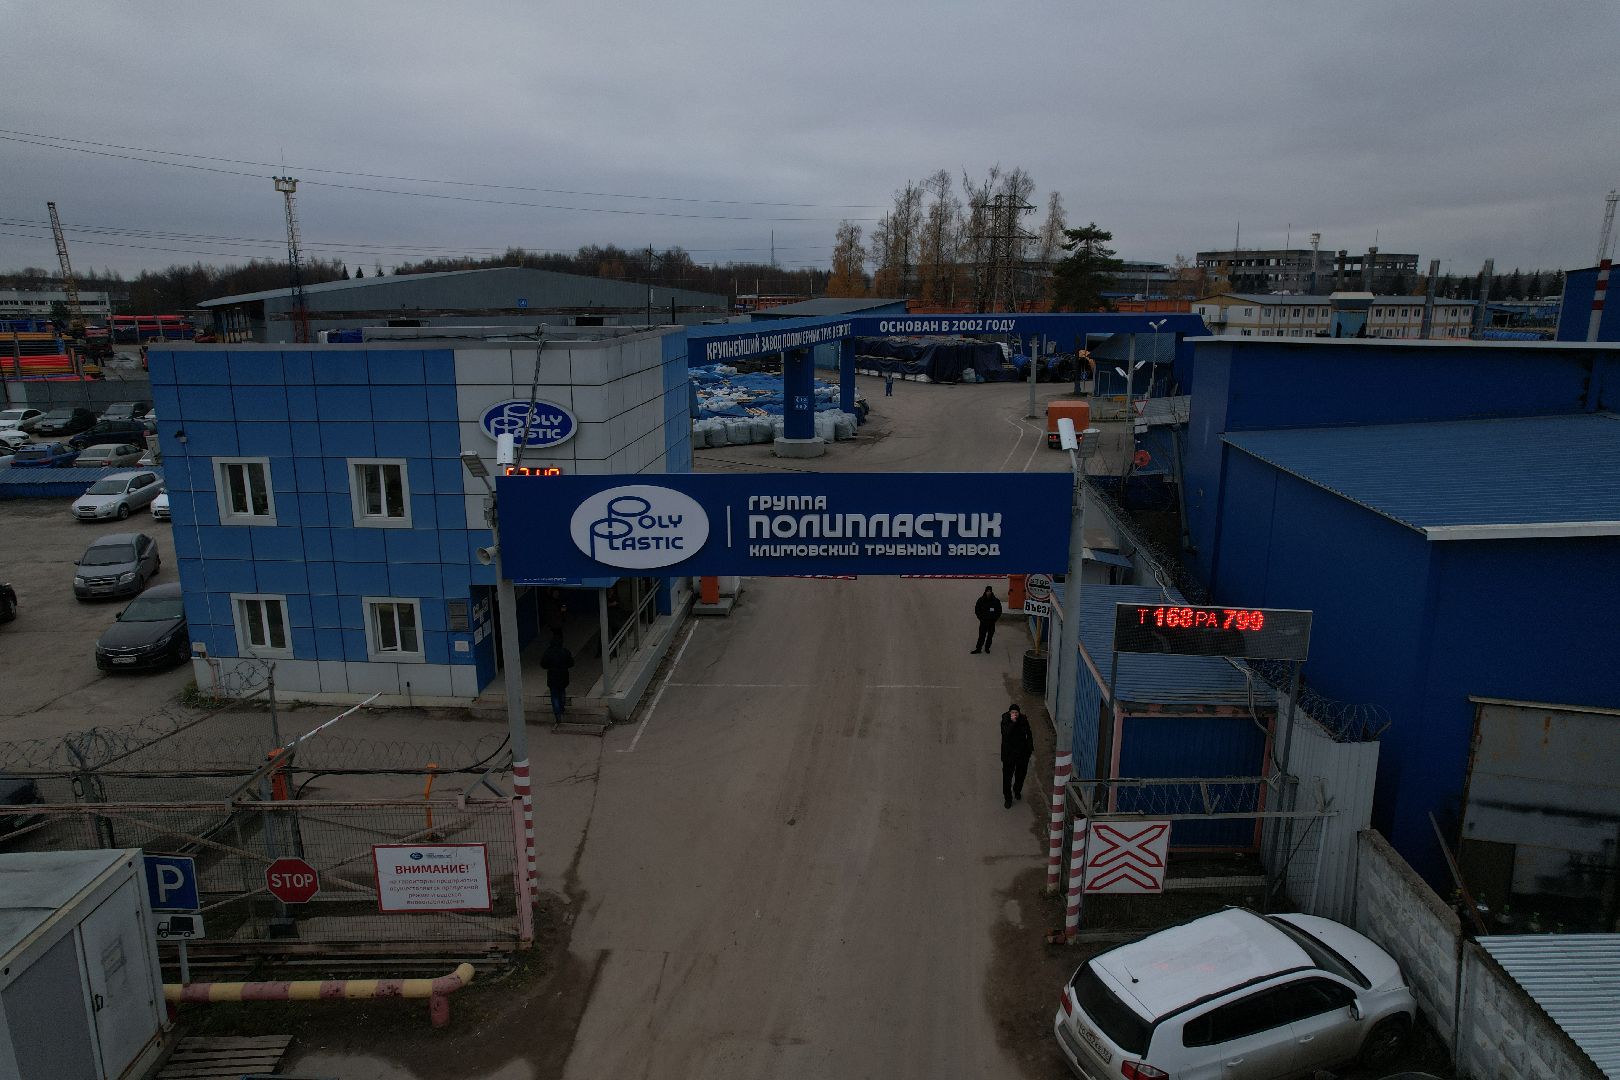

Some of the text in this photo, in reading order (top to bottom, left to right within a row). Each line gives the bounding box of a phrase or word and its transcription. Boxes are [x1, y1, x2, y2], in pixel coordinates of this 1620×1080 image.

[880, 319, 1016, 333] ОСНОВАН В 2002 ГОДУ
[706, 334, 760, 361] КРУПНЕЙШИЙ
[761, 334, 782, 353] ЗАВОД
[748, 495, 828, 511] ГРУППА
[607, 495, 683, 530] POLY
[748, 512, 1003, 539] ПОЛИПЛАСТИК
[749, 541, 1002, 557] КЛИМОВСКИЙ ТРУБНЫЙ ЗАВОД
[395, 864, 470, 875] ВНИМАНИЕ!
[155, 863, 186, 904] P
[271, 873, 314, 889] STOP
